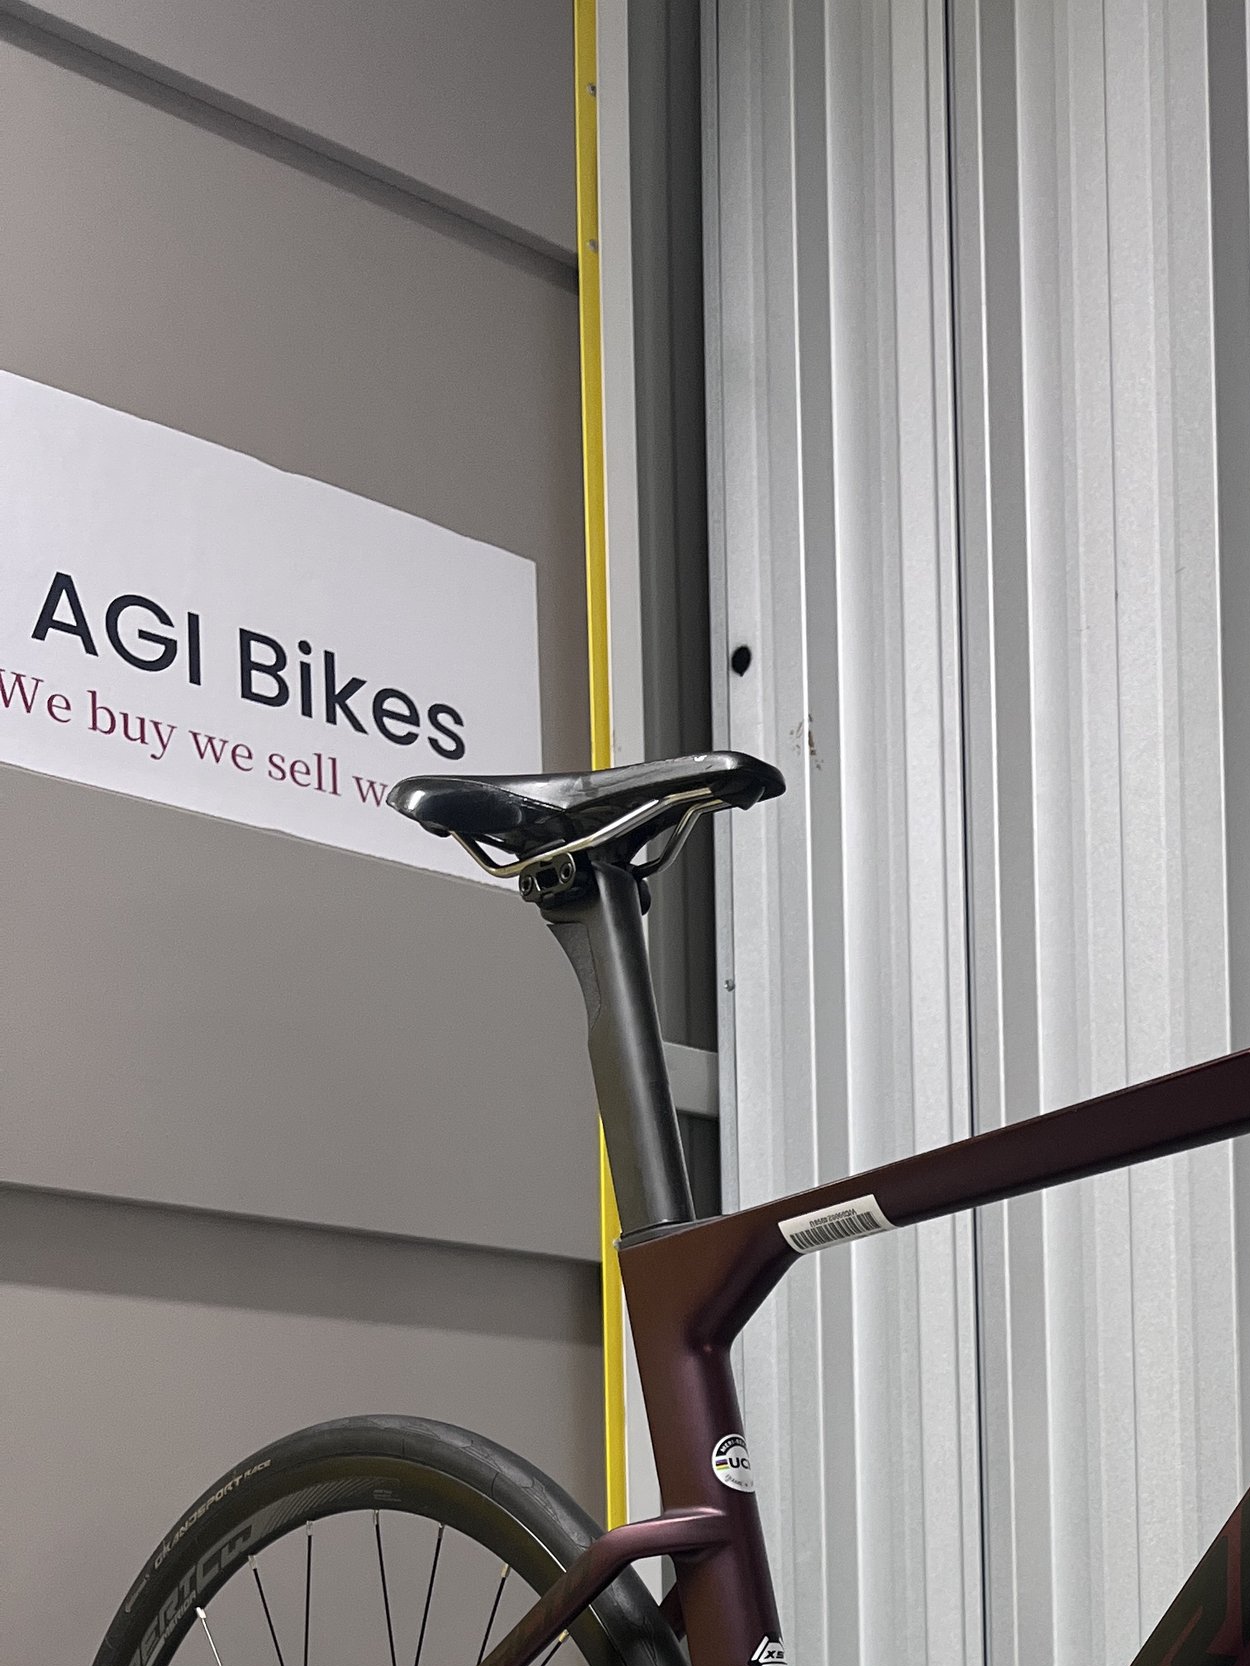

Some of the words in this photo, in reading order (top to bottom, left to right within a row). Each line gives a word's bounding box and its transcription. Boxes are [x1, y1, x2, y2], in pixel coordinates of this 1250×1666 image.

[31, 571, 201, 686] AGI
[239, 627, 466, 761] Bikes
[0, 668, 72, 724] We
[86, 689, 178, 760] buy
[188, 730, 254, 772] we
[267, 752, 342, 797] sell
[352, 775, 388, 808] w
[729, 1457, 751, 1470] UC
[763, 1650, 785, 1660] XS
